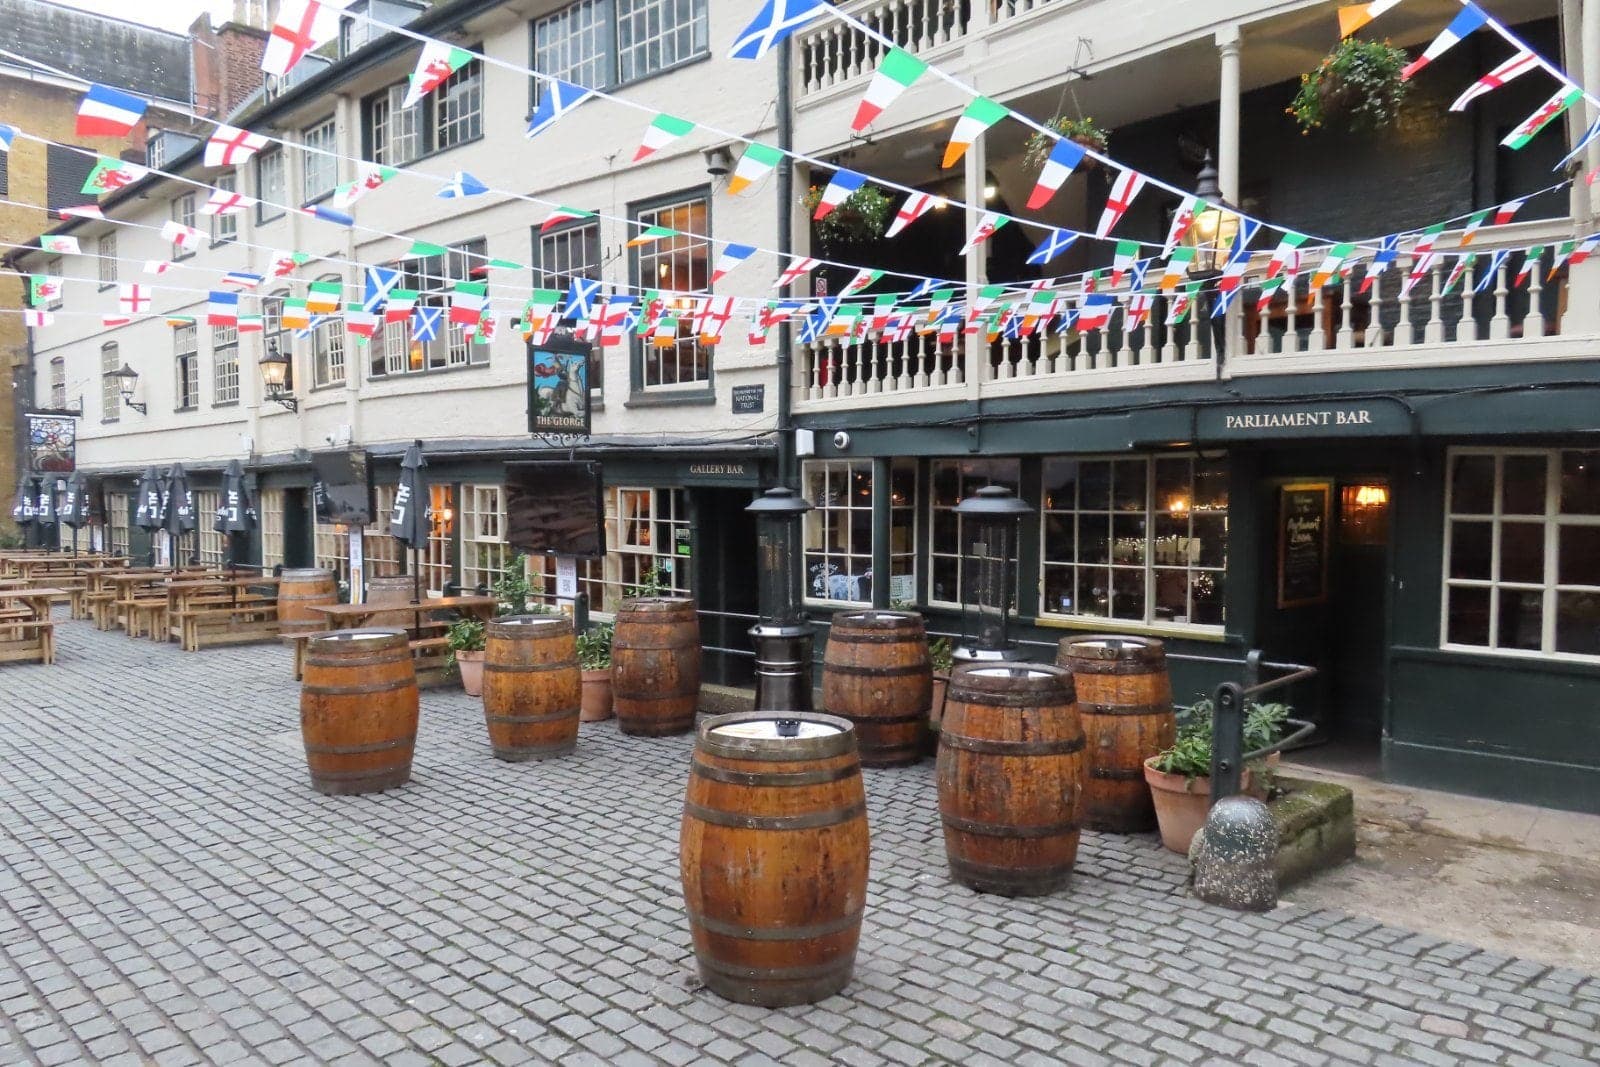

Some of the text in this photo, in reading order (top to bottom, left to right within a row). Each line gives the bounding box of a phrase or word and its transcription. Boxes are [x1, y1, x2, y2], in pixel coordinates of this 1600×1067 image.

[735, 394, 760, 402] NATIONAL
[536, 415, 585, 427] THE GEORGE
[1225, 410, 1373, 428] PARLIAMENT BAR
[690, 464, 744, 474] GALLERY BAR
